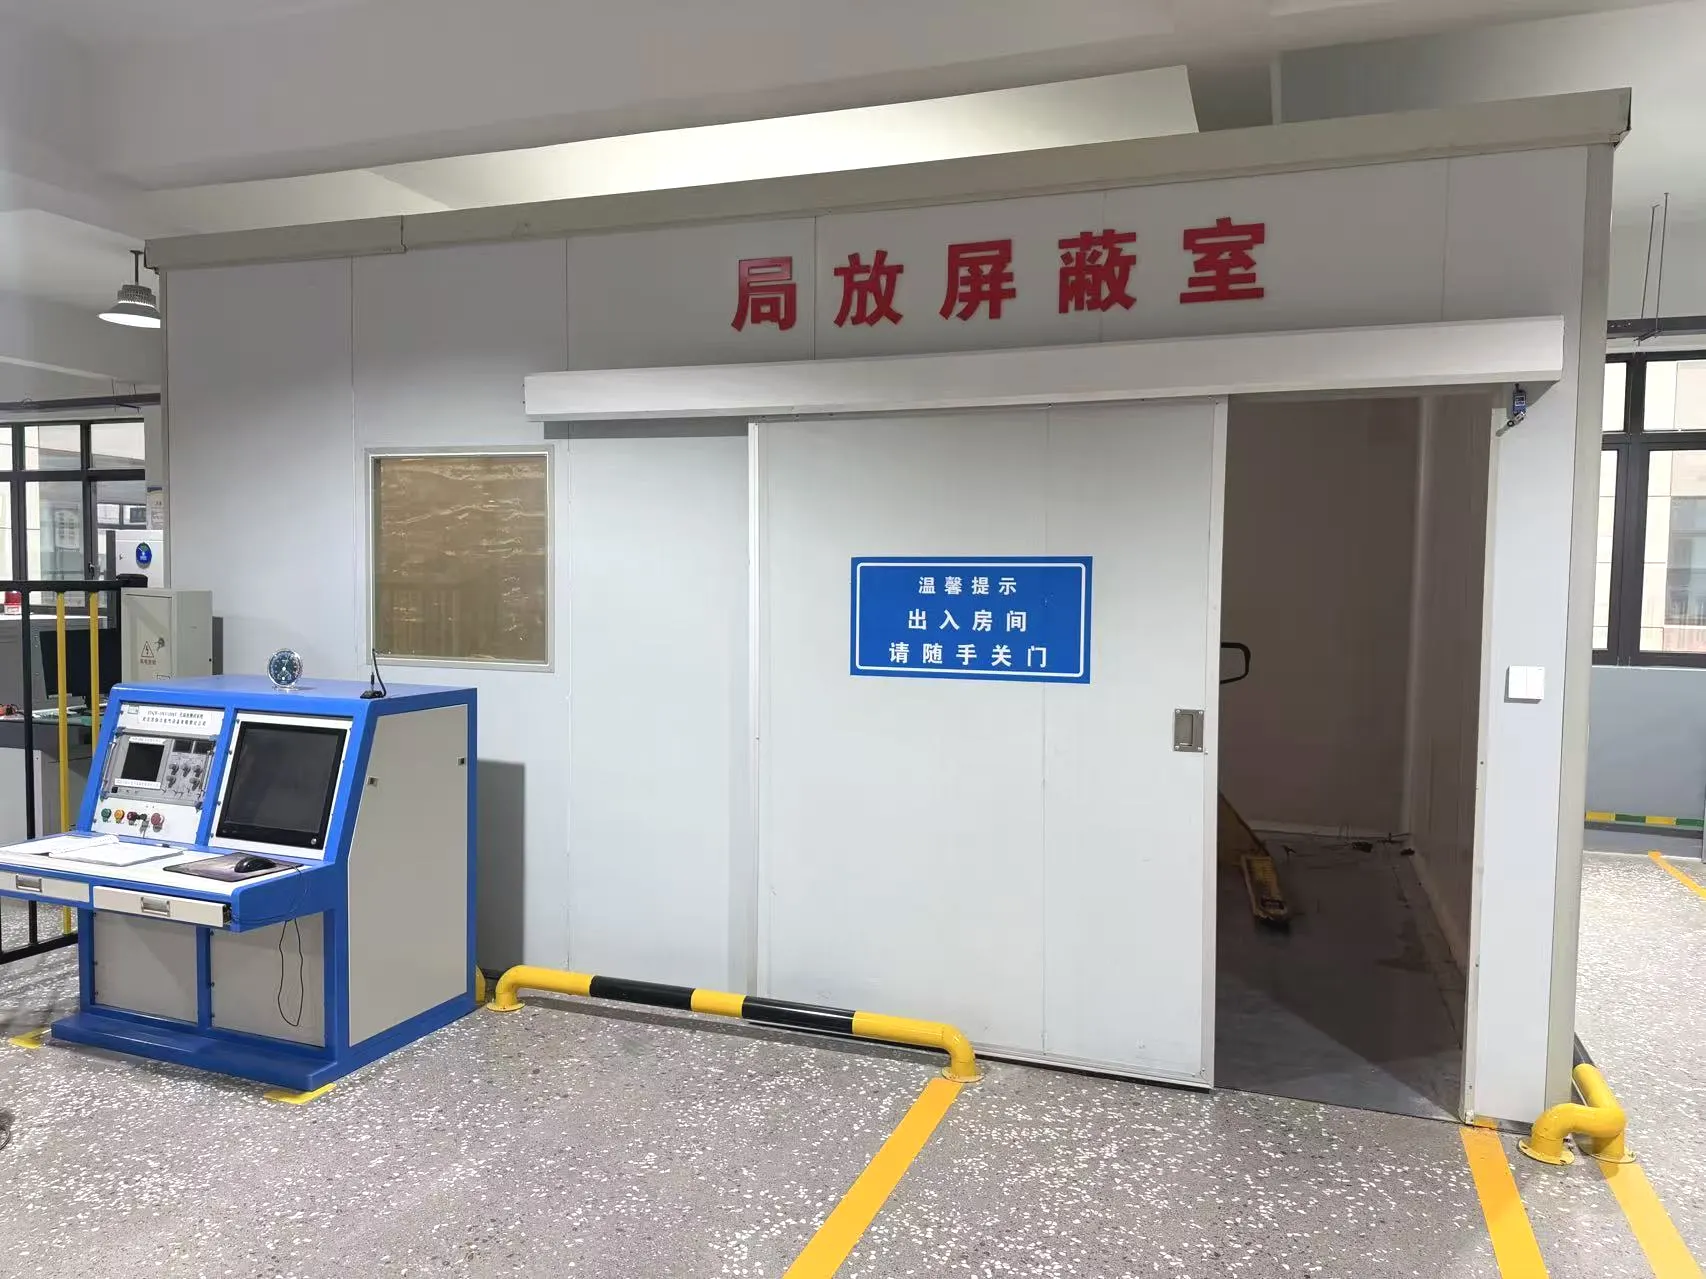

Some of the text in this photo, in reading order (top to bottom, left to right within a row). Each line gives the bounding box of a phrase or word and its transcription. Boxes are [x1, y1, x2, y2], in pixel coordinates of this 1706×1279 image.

[731, 217, 1265, 332] 局放屏蔽室
[918, 576, 1017, 595] 温馨提示
[908, 608, 1027, 632] 出入房间
[889, 641, 1047, 667] 请随手关门
